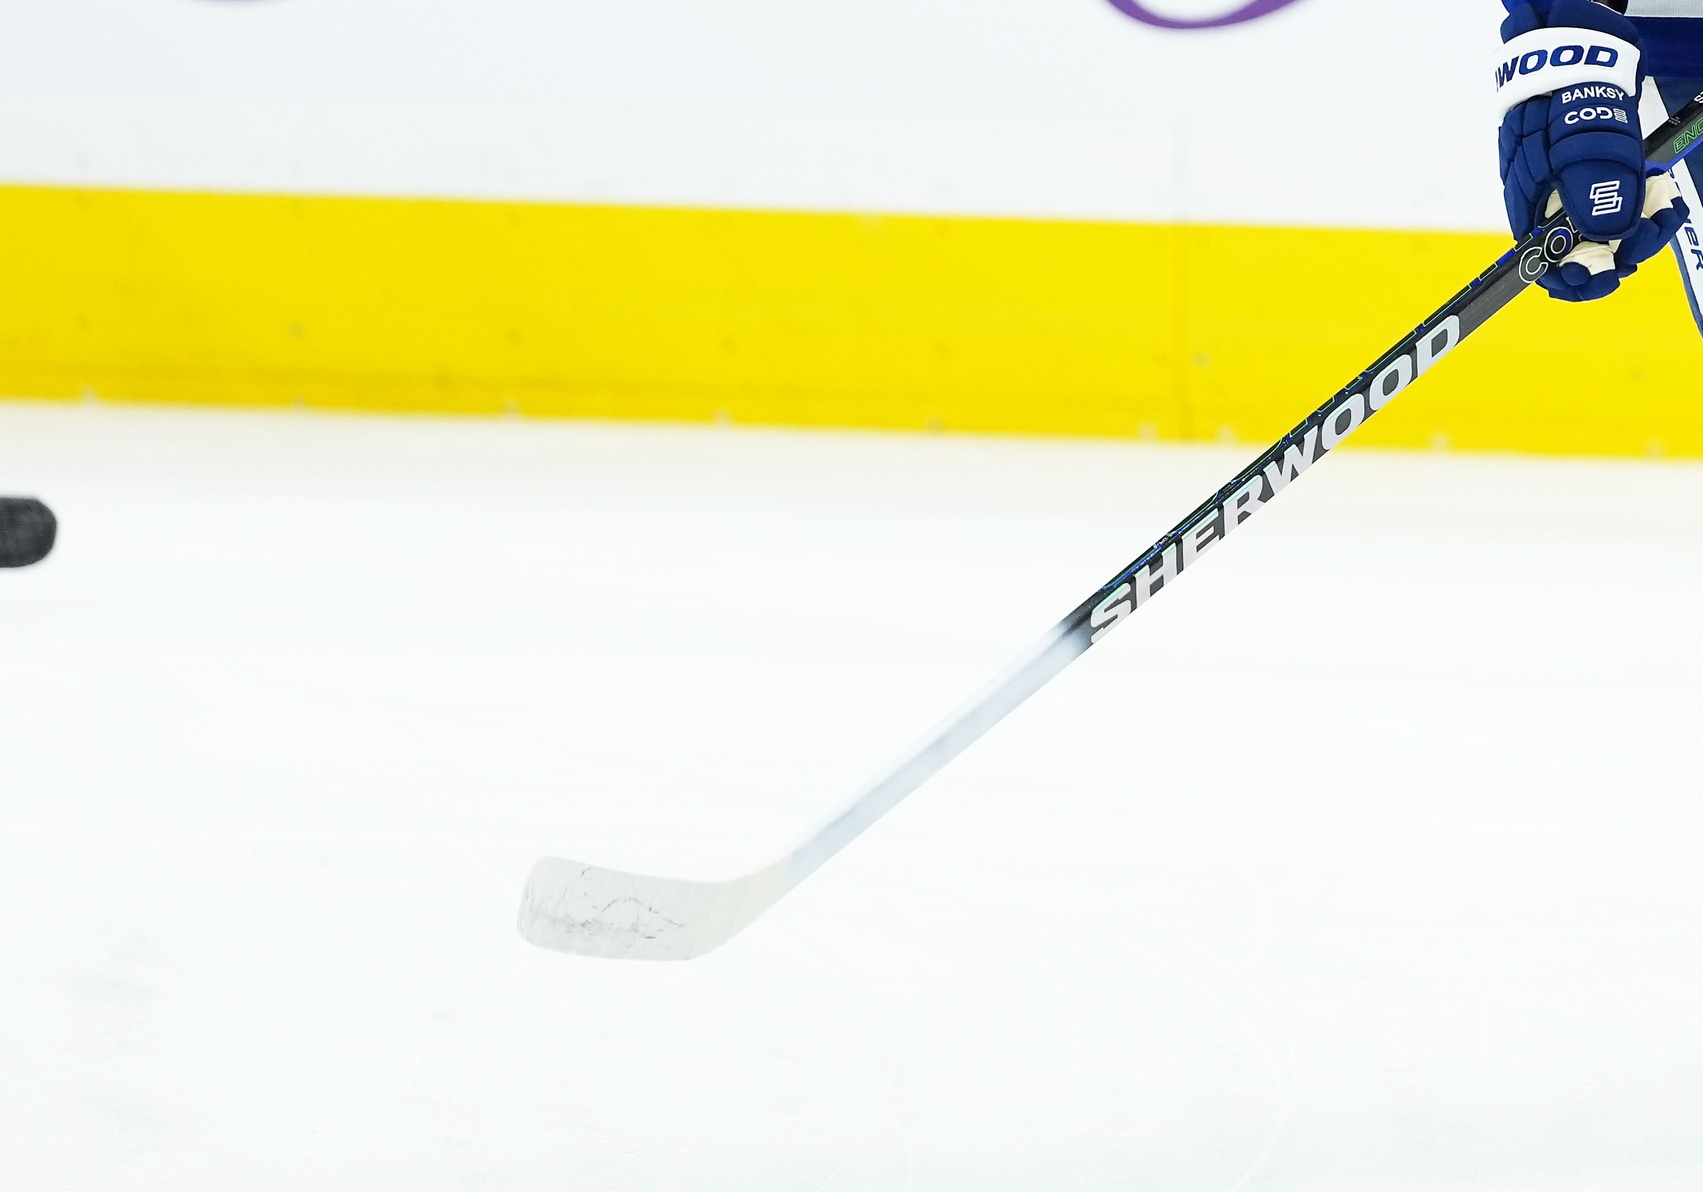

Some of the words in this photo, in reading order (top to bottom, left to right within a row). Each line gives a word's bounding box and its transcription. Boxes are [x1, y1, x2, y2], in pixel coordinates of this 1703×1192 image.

[1495, 44, 1619, 93] WOOD
[1561, 85, 1626, 105] BANKSY
[1089, 314, 1461, 645] SHERWOOD
